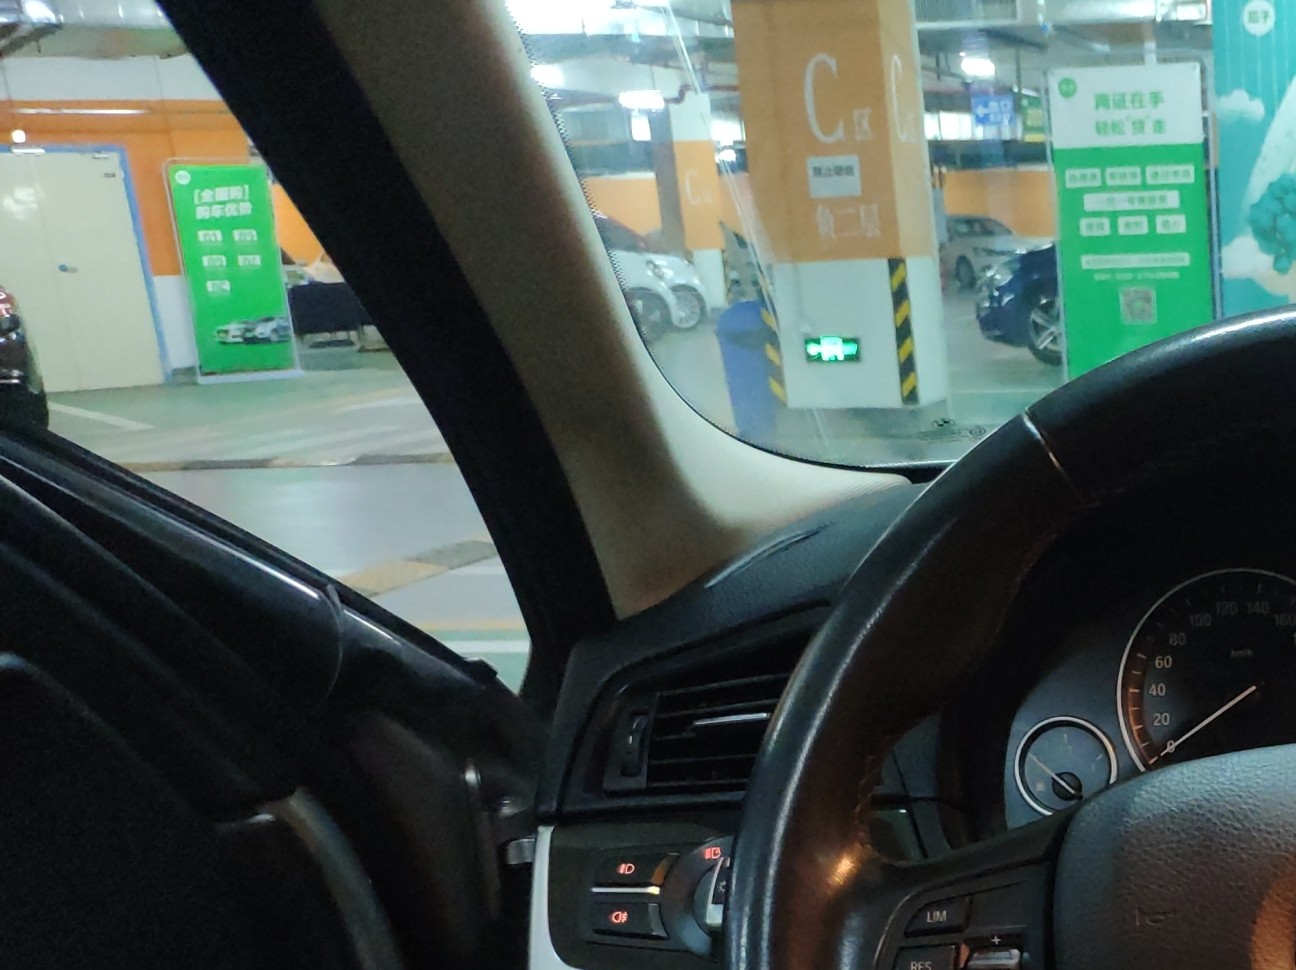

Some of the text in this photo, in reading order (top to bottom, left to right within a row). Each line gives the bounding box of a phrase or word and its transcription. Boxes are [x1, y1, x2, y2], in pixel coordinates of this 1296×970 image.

[1169, 632, 1187, 646] 80
[1155, 655, 1172, 669] 60
[1149, 683, 1167, 697] 40
[1153, 712, 1171, 726] 20
[926, 910, 947, 923] LIM
